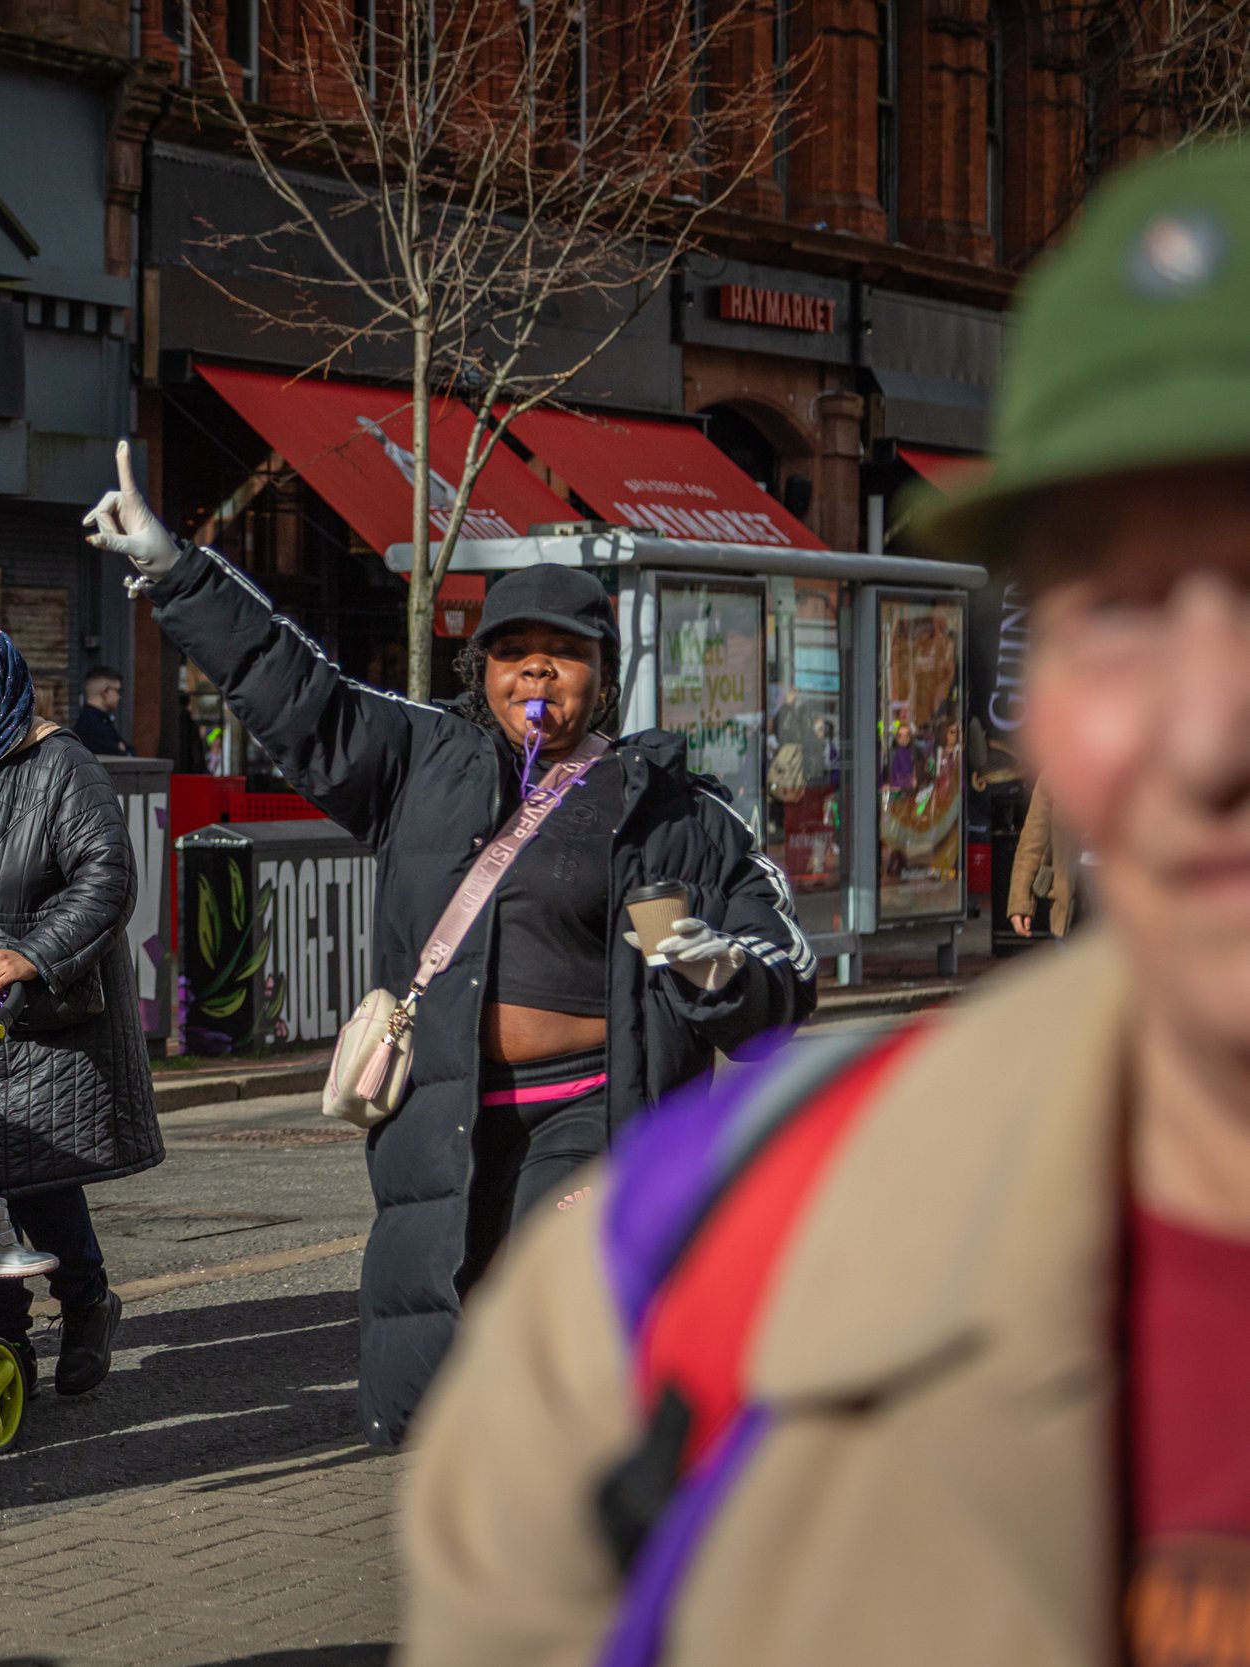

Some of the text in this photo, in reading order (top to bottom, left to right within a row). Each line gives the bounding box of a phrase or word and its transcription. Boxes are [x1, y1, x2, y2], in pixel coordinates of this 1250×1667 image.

[730, 284, 837, 333] HAYMARKET
[613, 502, 792, 545] HAYMARKET
[667, 630, 724, 667] What
[706, 673, 745, 711] you
[259, 857, 377, 1043] TOGETH
